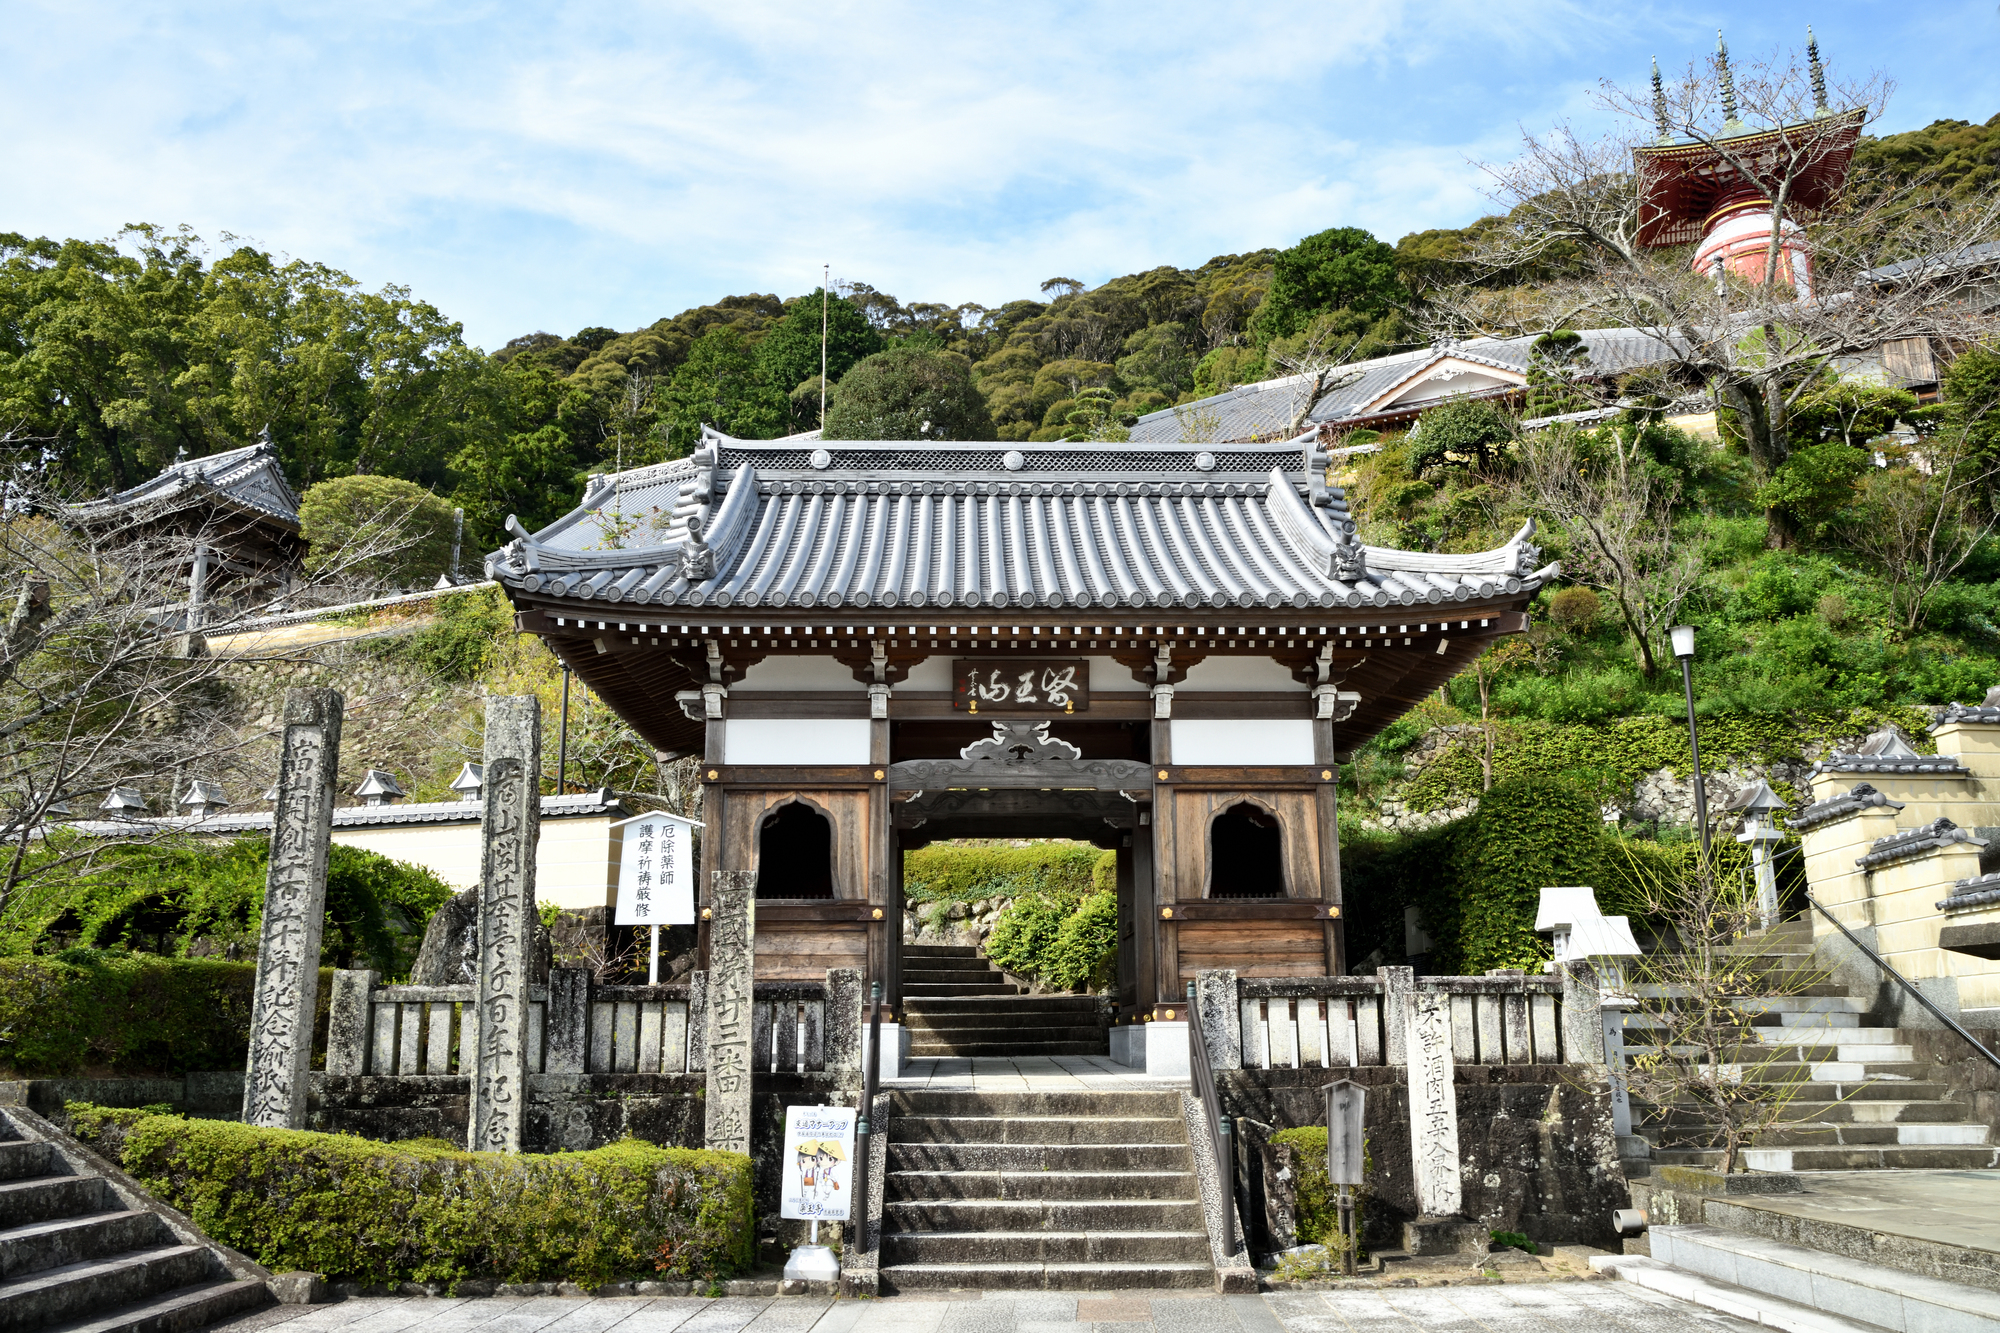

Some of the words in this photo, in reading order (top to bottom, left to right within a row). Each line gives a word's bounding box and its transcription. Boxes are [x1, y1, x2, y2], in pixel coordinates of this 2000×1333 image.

[634, 824, 655, 917] 護摩祈祷厳修
[660, 824, 676, 885] 厄除薬師
[795, 1119, 847, 1129] 交通マナーアップ
